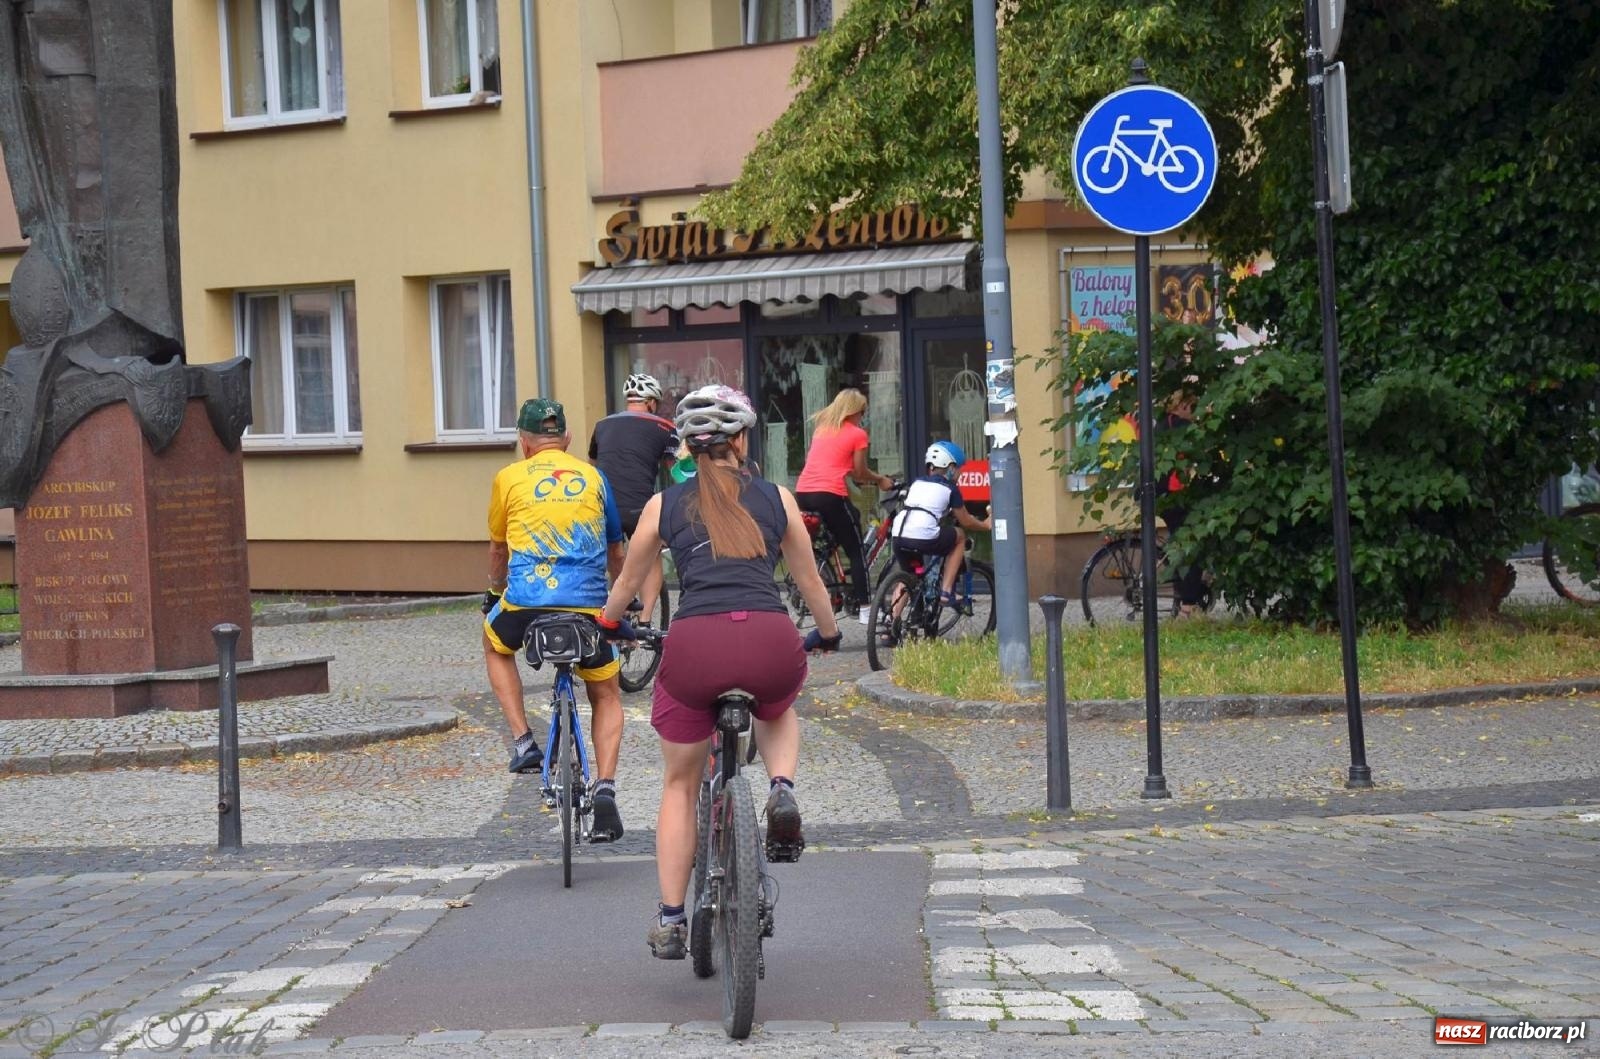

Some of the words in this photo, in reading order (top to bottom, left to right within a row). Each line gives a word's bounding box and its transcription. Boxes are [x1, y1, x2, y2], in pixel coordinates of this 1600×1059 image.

[1072, 270, 1132, 297] Balony
[1080, 300, 1088, 316] z
[43, 481, 116, 493] ARCYBISKUP
[80, 503, 133, 518] FELIKS
[44, 528, 114, 542] GAWLINA
